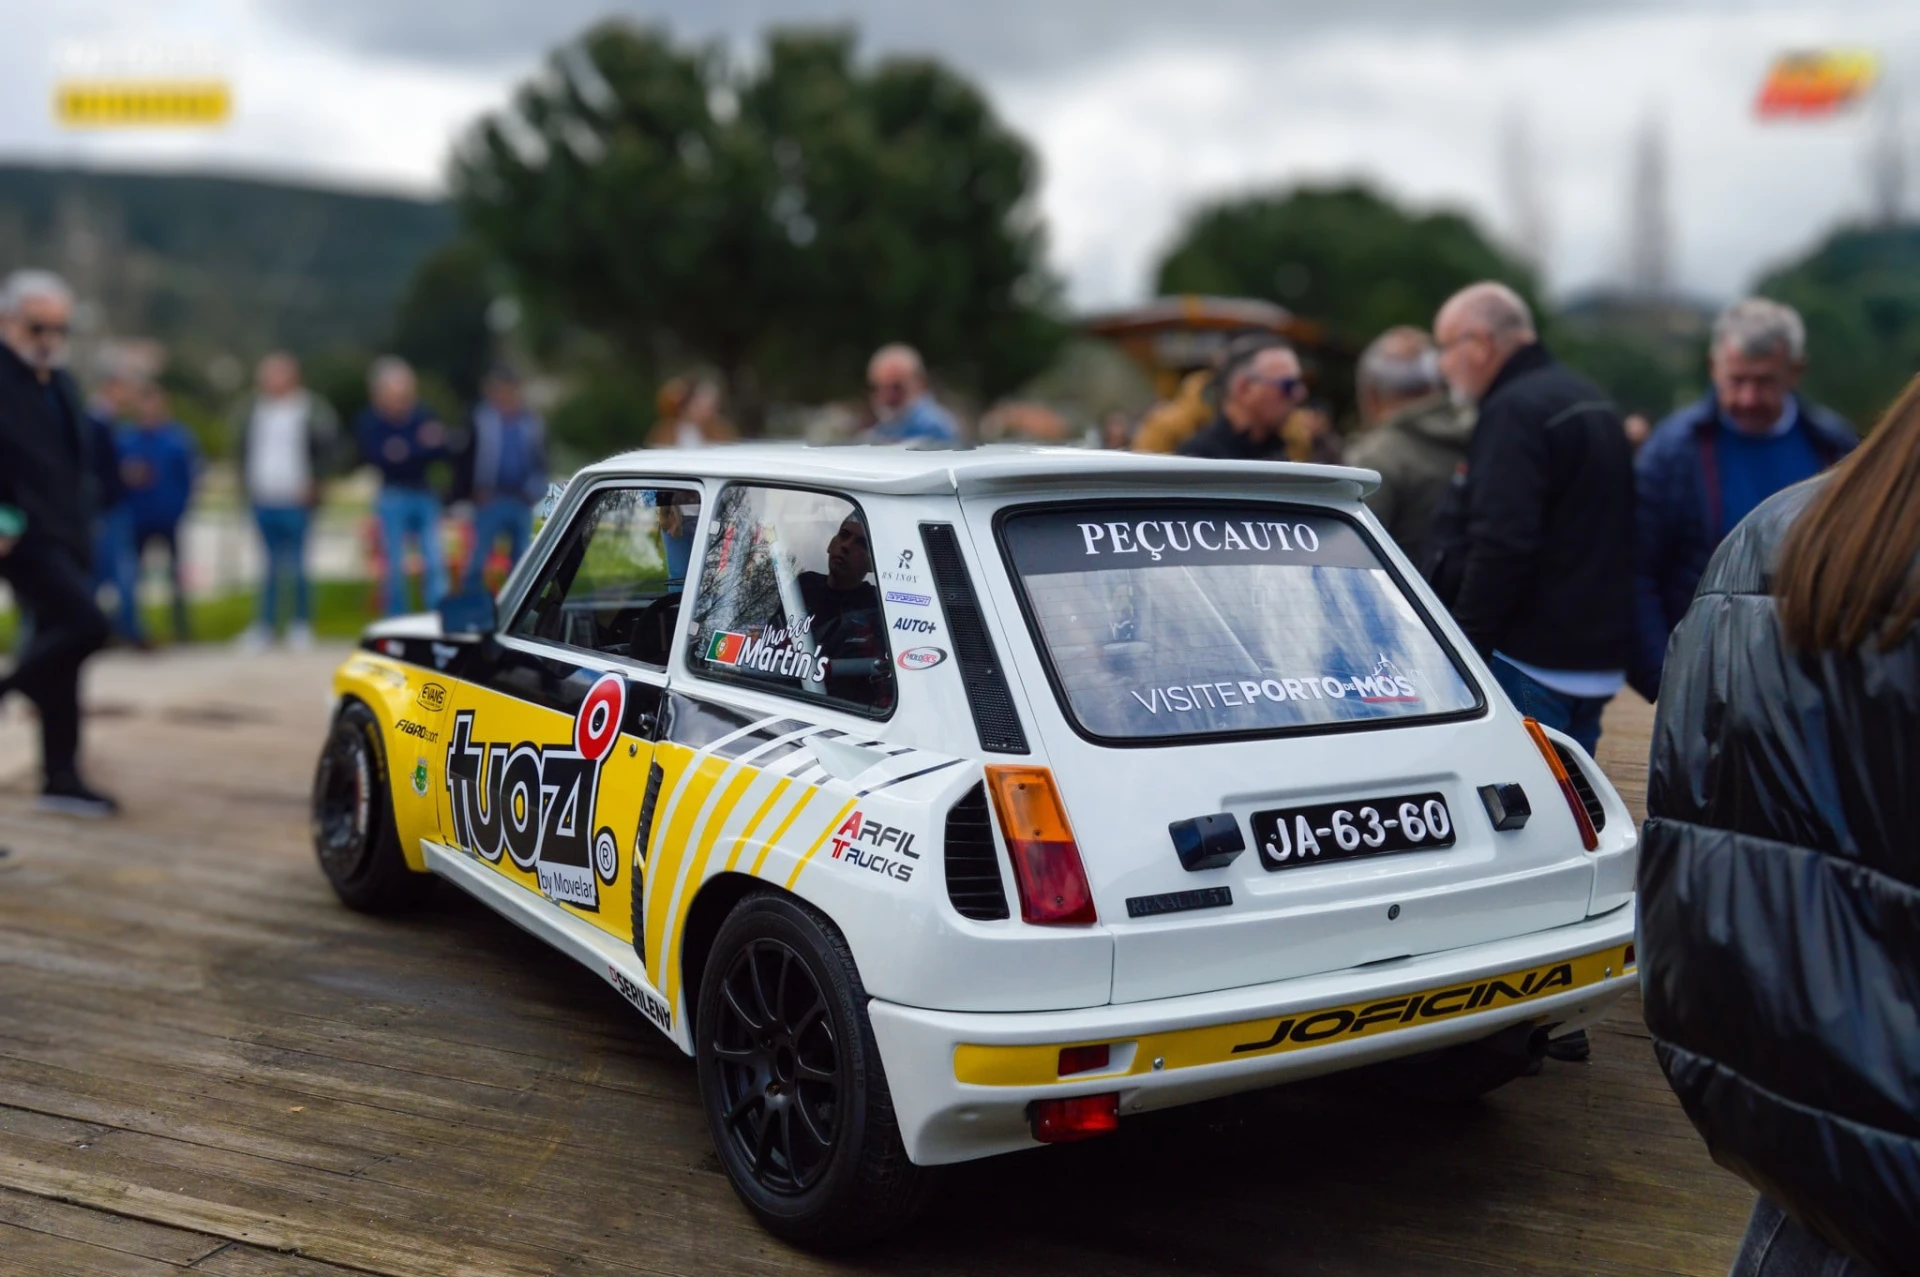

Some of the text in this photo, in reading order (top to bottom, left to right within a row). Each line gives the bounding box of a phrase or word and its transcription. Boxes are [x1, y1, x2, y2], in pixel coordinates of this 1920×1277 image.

[1076, 520, 1320, 561] PEÇUCAUTO
[892, 617, 937, 634] AUTO+
[737, 636, 830, 683] Martin's
[421, 686, 445, 704] EVANS
[837, 810, 921, 860] ARFIL
[1265, 799, 1450, 862] JA-63-60
[540, 868, 593, 898] by Movelar
[831, 838, 914, 883] TRUCKS
[1230, 963, 1573, 1054] JOFICINA
